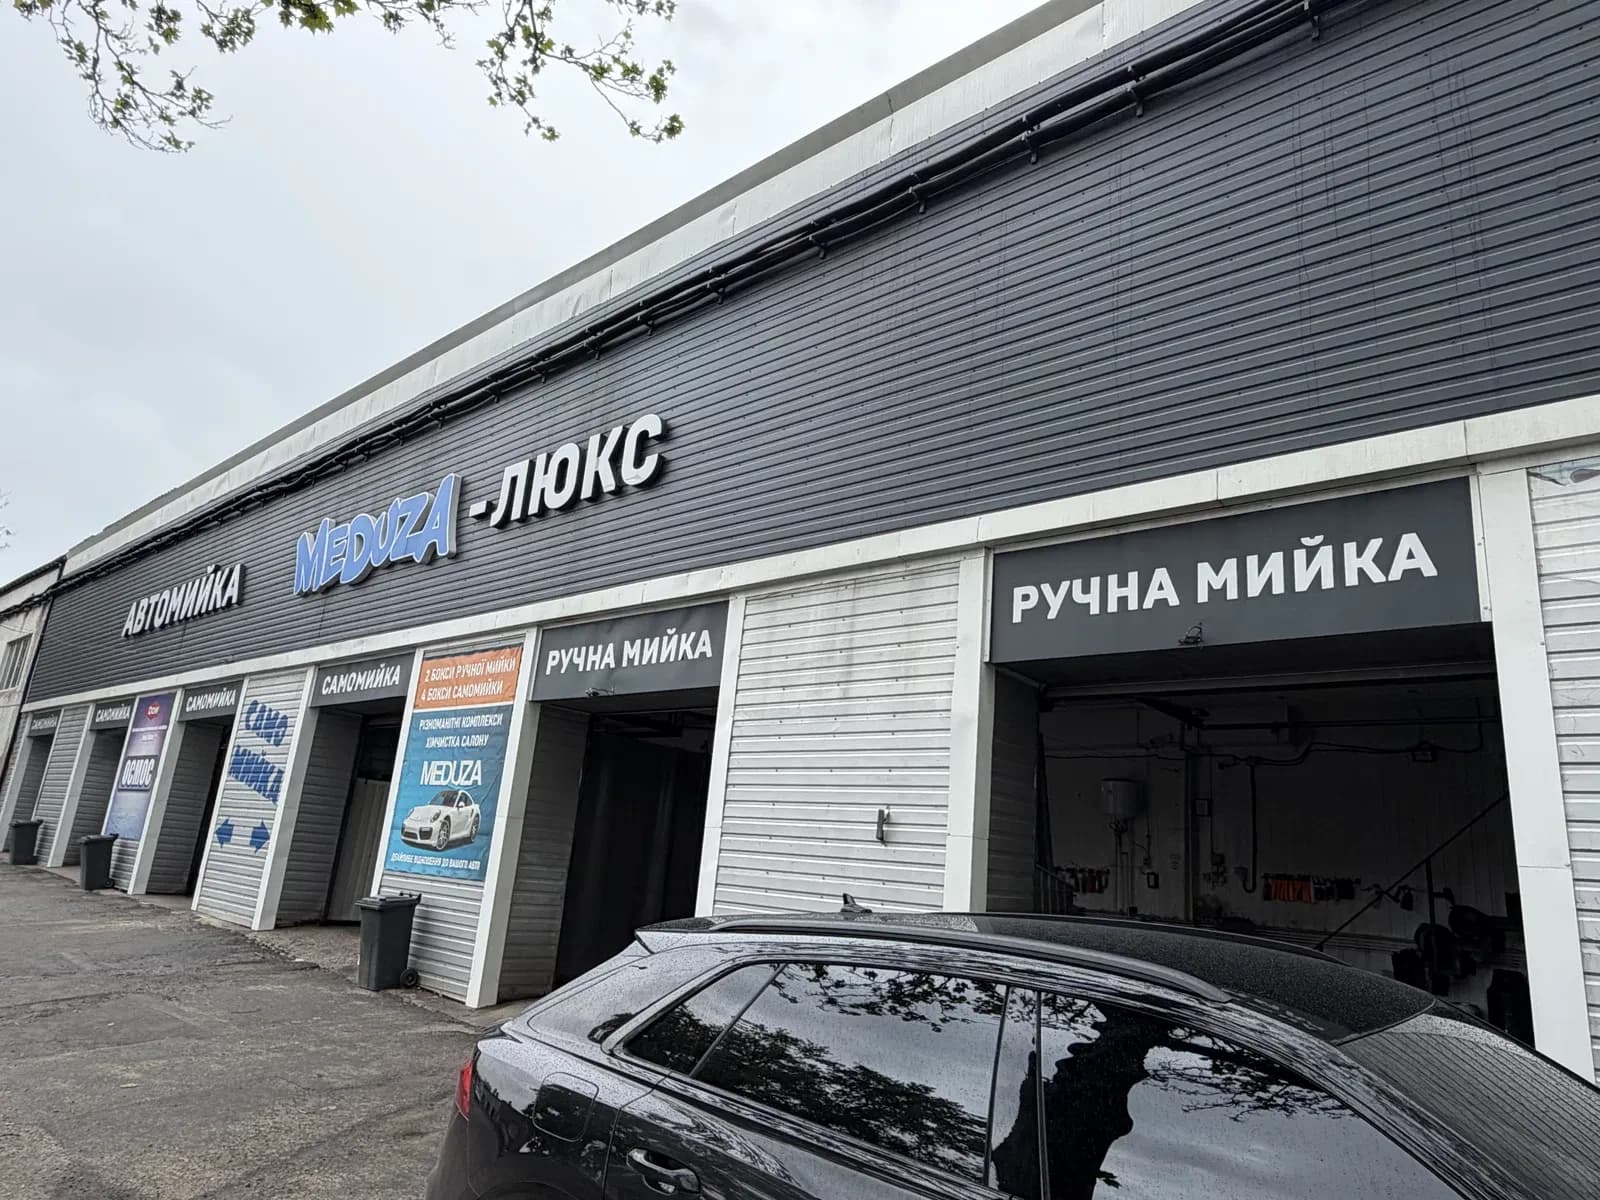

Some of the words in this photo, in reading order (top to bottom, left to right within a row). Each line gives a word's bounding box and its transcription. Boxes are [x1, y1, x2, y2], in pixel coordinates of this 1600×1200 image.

[293, 473, 460, 596] MEDUZA
[1012, 567, 1180, 624] РУЧНА
[1197, 532, 1438, 604] МИЙКА
[121, 563, 243, 638] АВТОМИЙКА
[545, 641, 615, 676] РУЧНА
[621, 627, 713, 667] МИЙКА
[321, 663, 401, 695] САМОМИЙКА
[425, 670, 430, 682] 2
[431, 667, 455, 681] БОКСИ
[456, 659, 485, 678] РУЧНОЇ
[485, 656, 515, 674] МИЙКИ
[186, 687, 237, 713] САМОМИЙКА
[421, 688, 426, 700] 4
[427, 686, 451, 700] БОКСИ
[452, 679, 503, 698] САМОМИЙКИ
[245, 700, 288, 746] САМО
[419, 717, 461, 730] РІЗНОМАНІТНІ
[461, 713, 503, 728] КОМПЛЕКСИ
[425, 736, 459, 748] ХІМЧИСТКА
[461, 734, 489, 747] САЛОНУ
[121, 758, 155, 785] ОСМОС
[420, 760, 482, 786] MEDUZA
